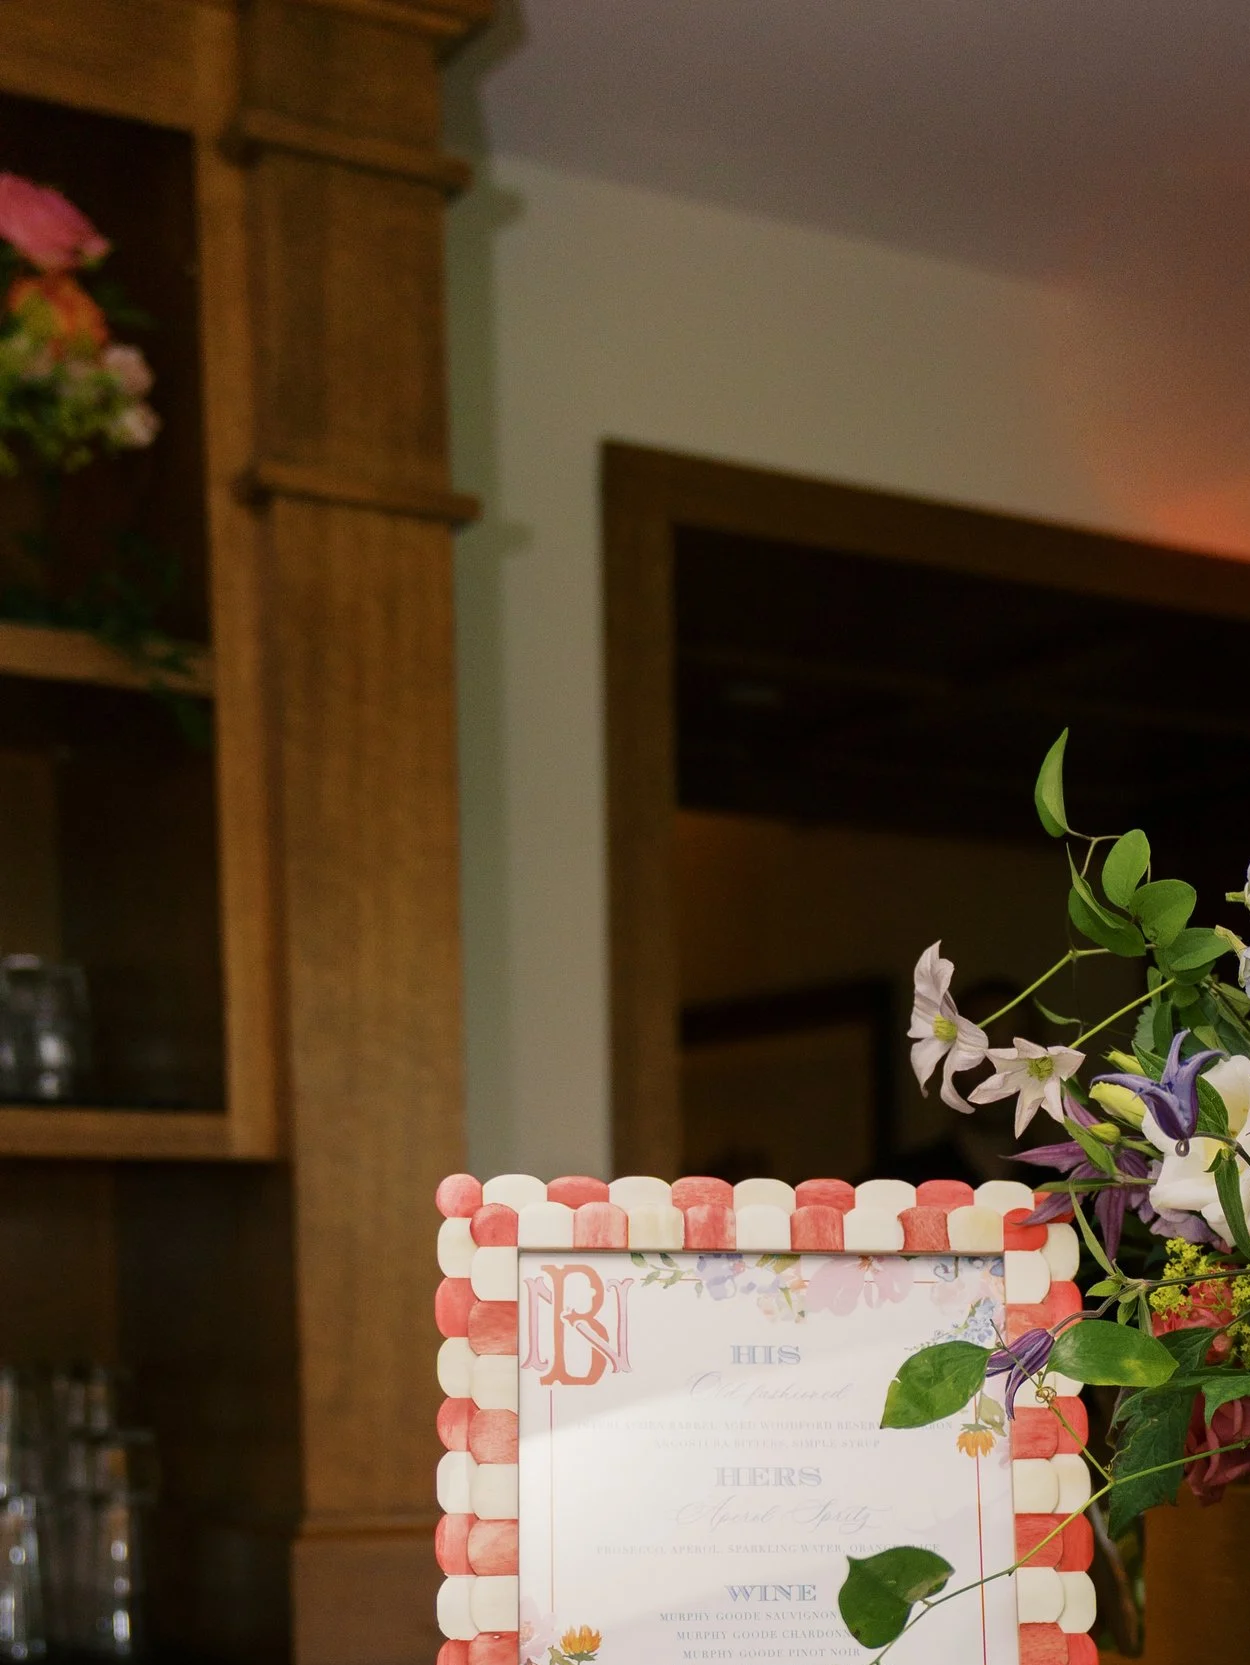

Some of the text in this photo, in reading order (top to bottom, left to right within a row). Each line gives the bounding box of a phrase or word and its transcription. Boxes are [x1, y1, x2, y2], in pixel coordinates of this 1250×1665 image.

[730, 1344, 802, 1366] HIS
[837, 1420, 880, 1431] RESERV
[792, 1437, 837, 1449] SIMPLE
[841, 1437, 880, 1449] SYRUP
[713, 1465, 823, 1488] HERS
[672, 1495, 893, 1535] Aperol Spritz
[727, 1543, 797, 1555] SPARKLING
[849, 1542, 899, 1553] ORANG
[723, 1584, 817, 1603] WINE
[659, 1611, 836, 1622] MURPHY GOODE SAUVIGNON
[676, 1630, 852, 1641] MURPHY GOODE CHARDONN
[683, 1648, 860, 1660] MURPHY GOODE PINOT NOIR
